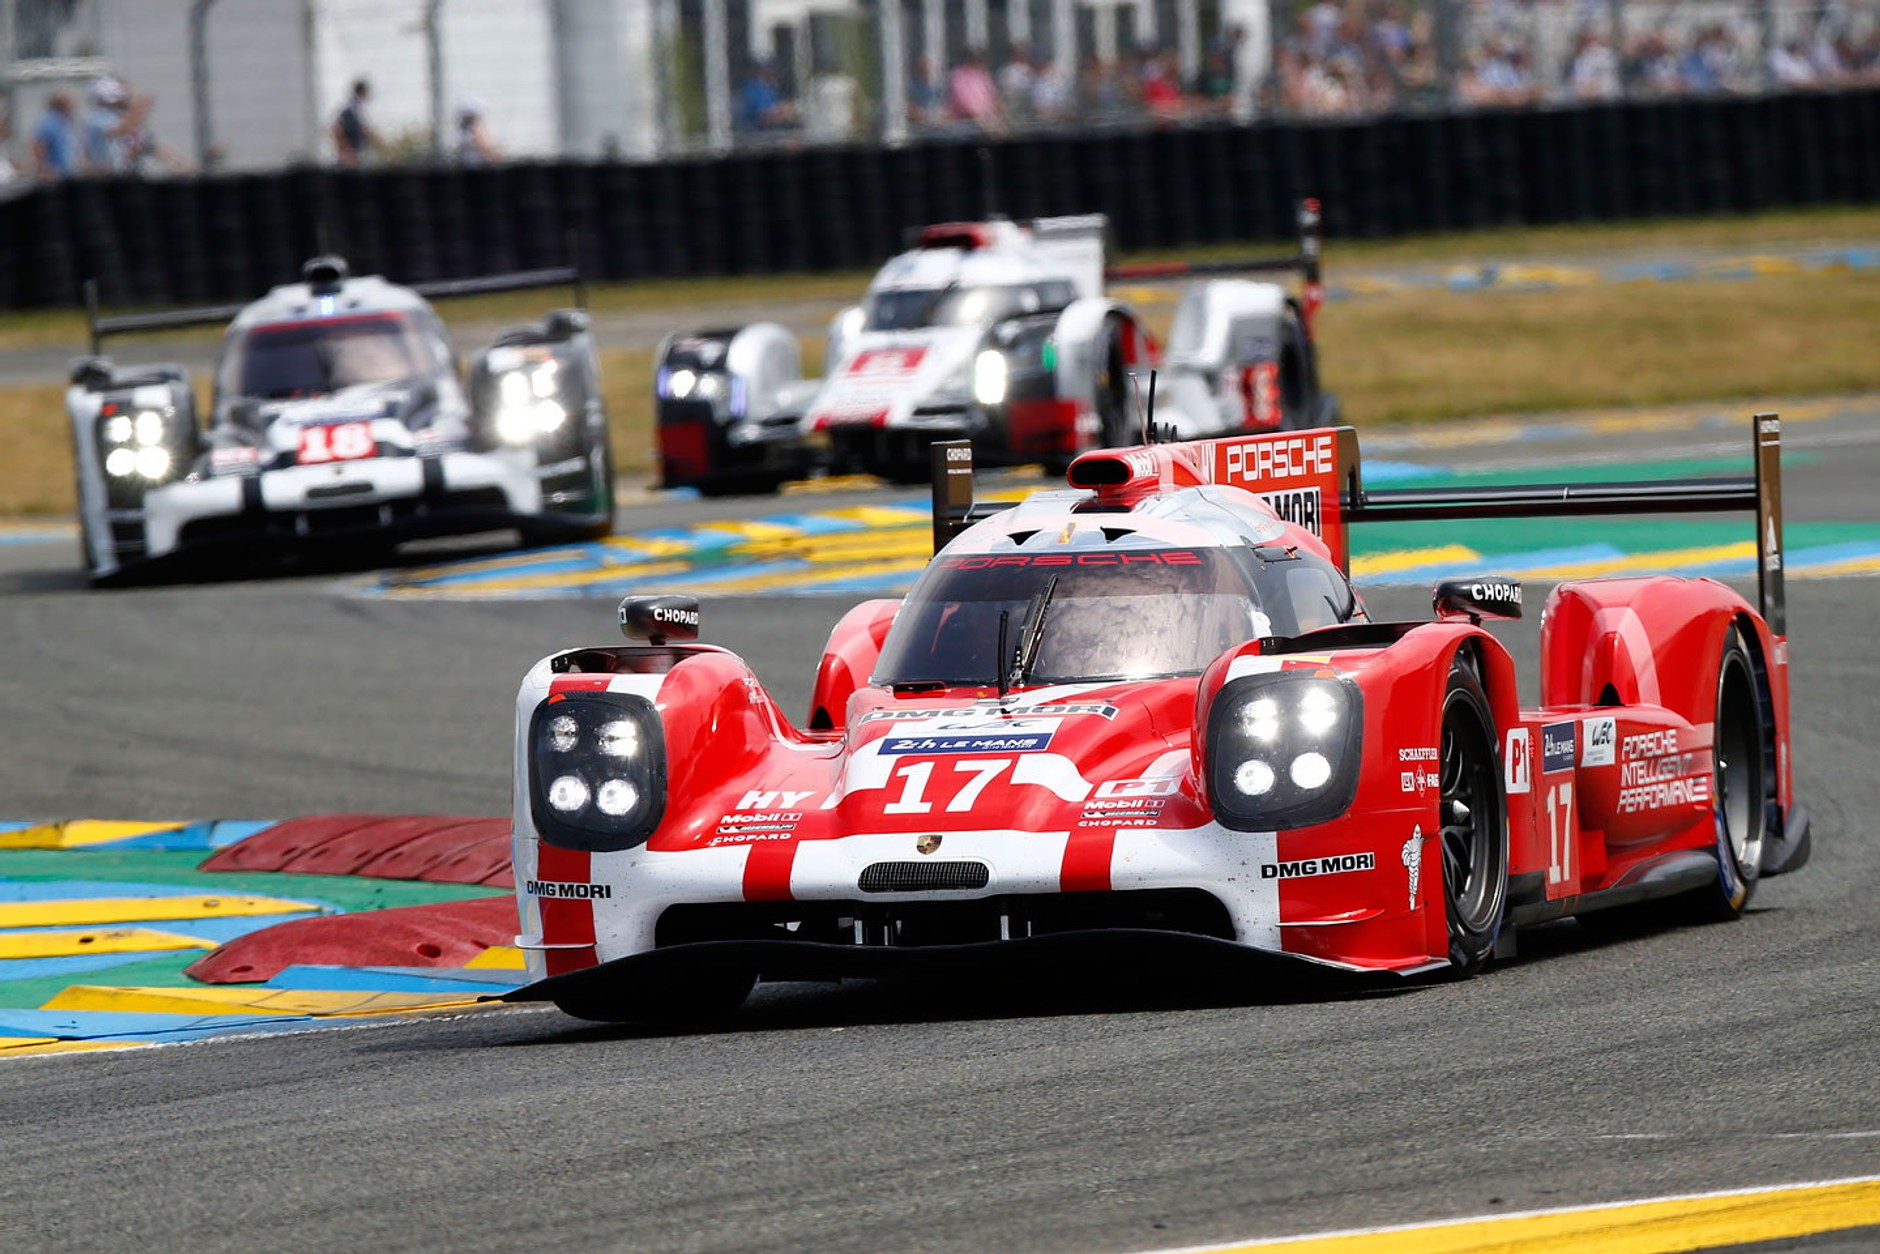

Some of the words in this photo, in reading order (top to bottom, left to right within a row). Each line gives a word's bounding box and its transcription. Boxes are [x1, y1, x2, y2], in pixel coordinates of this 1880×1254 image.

[301, 422, 374, 464] 18
[1226, 436, 1333, 483] PORSCHE
[938, 551, 1203, 570] PORSCHE
[860, 709, 971, 724] DMG
[985, 704, 1117, 721] MORI
[1621, 730, 1678, 761] PORSCHE
[1511, 737, 1528, 784] P1
[1621, 752, 1694, 787] INTELLIGENT
[883, 759, 1012, 814] 17
[1110, 780, 1172, 794] P1
[735, 790, 816, 809] HY
[1083, 800, 1143, 809] Mobil
[720, 813, 780, 824] Mobil
[712, 833, 792, 843] CHOPARD
[1547, 782, 1572, 884] 17
[1261, 861, 1318, 879] DMG
[1321, 853, 1374, 874] MORI
[526, 880, 557, 896] DMG
[558, 884, 612, 899] MORI
